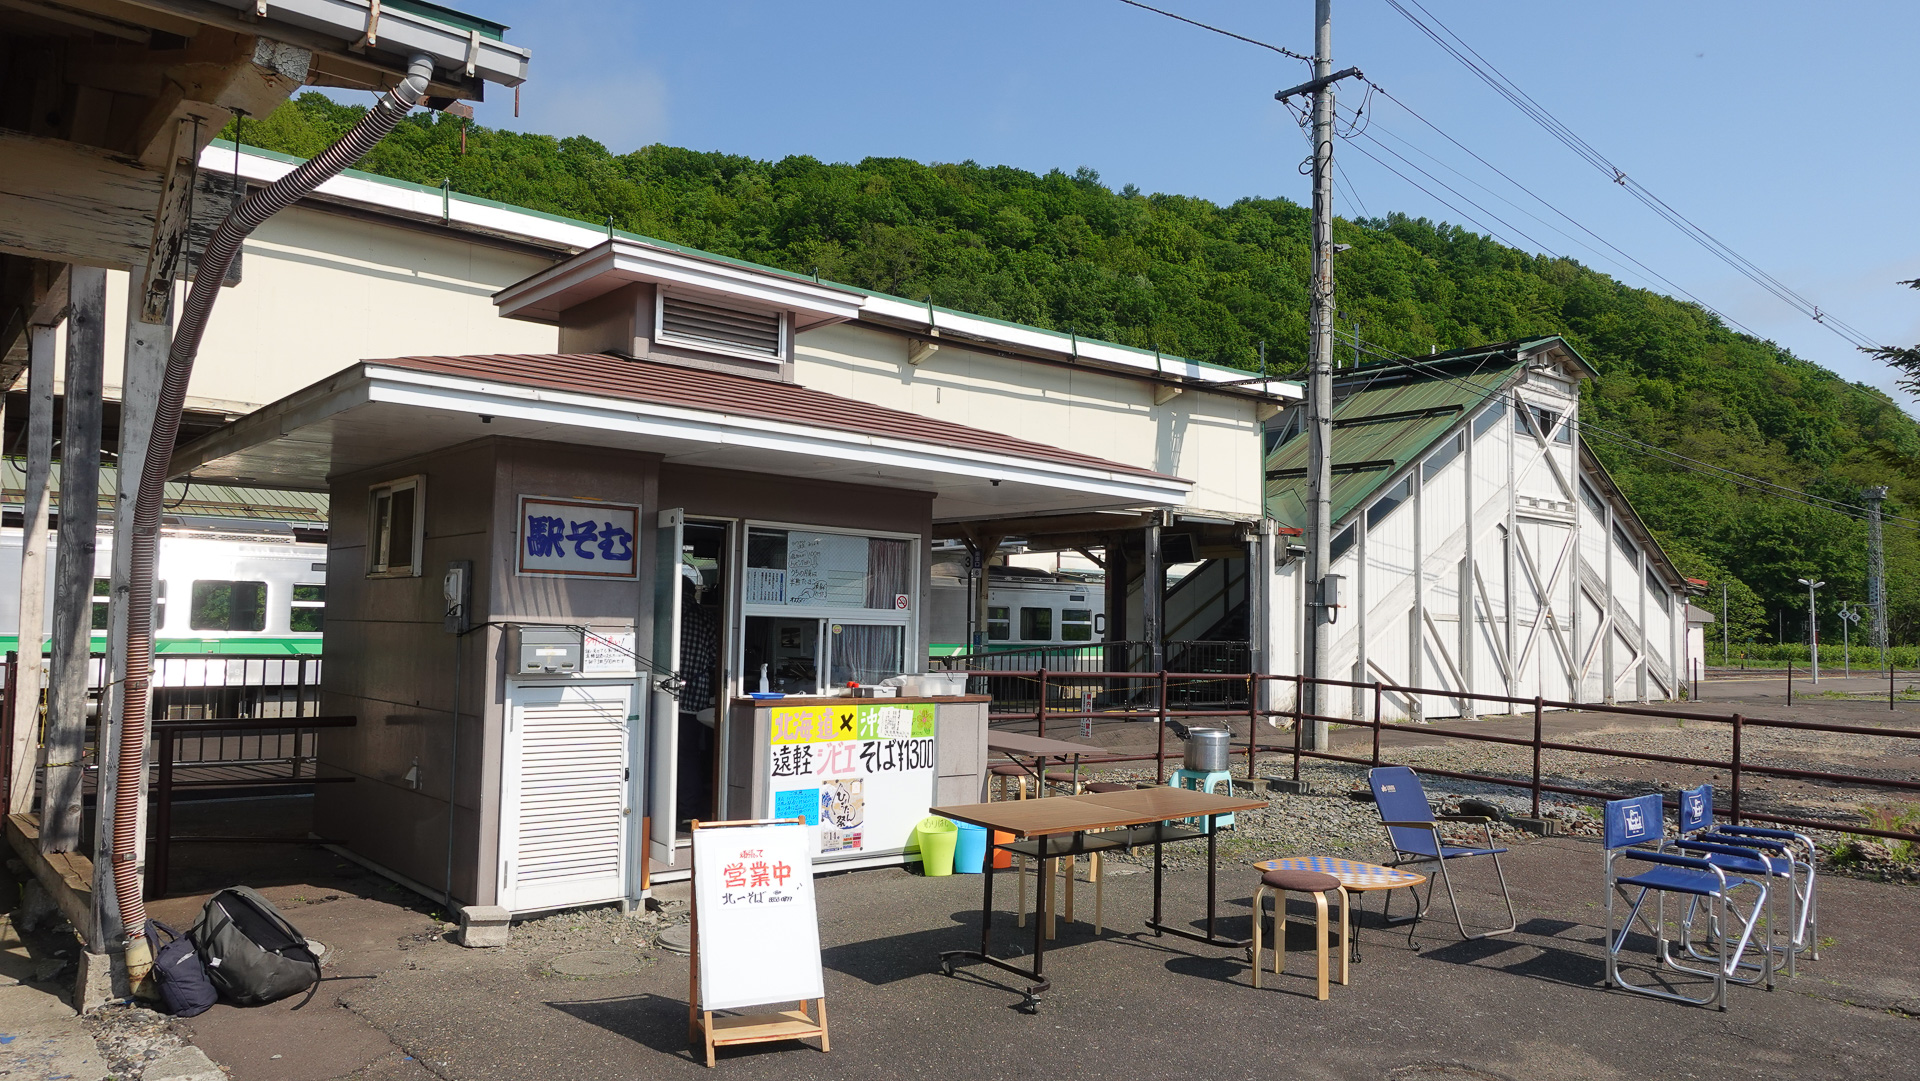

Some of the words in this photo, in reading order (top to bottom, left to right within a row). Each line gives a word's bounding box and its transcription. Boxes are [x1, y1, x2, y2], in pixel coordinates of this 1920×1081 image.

[964, 556, 971, 568] 3
[723, 861, 792, 888] 営業中
[722, 890, 767, 905] 北一そば
